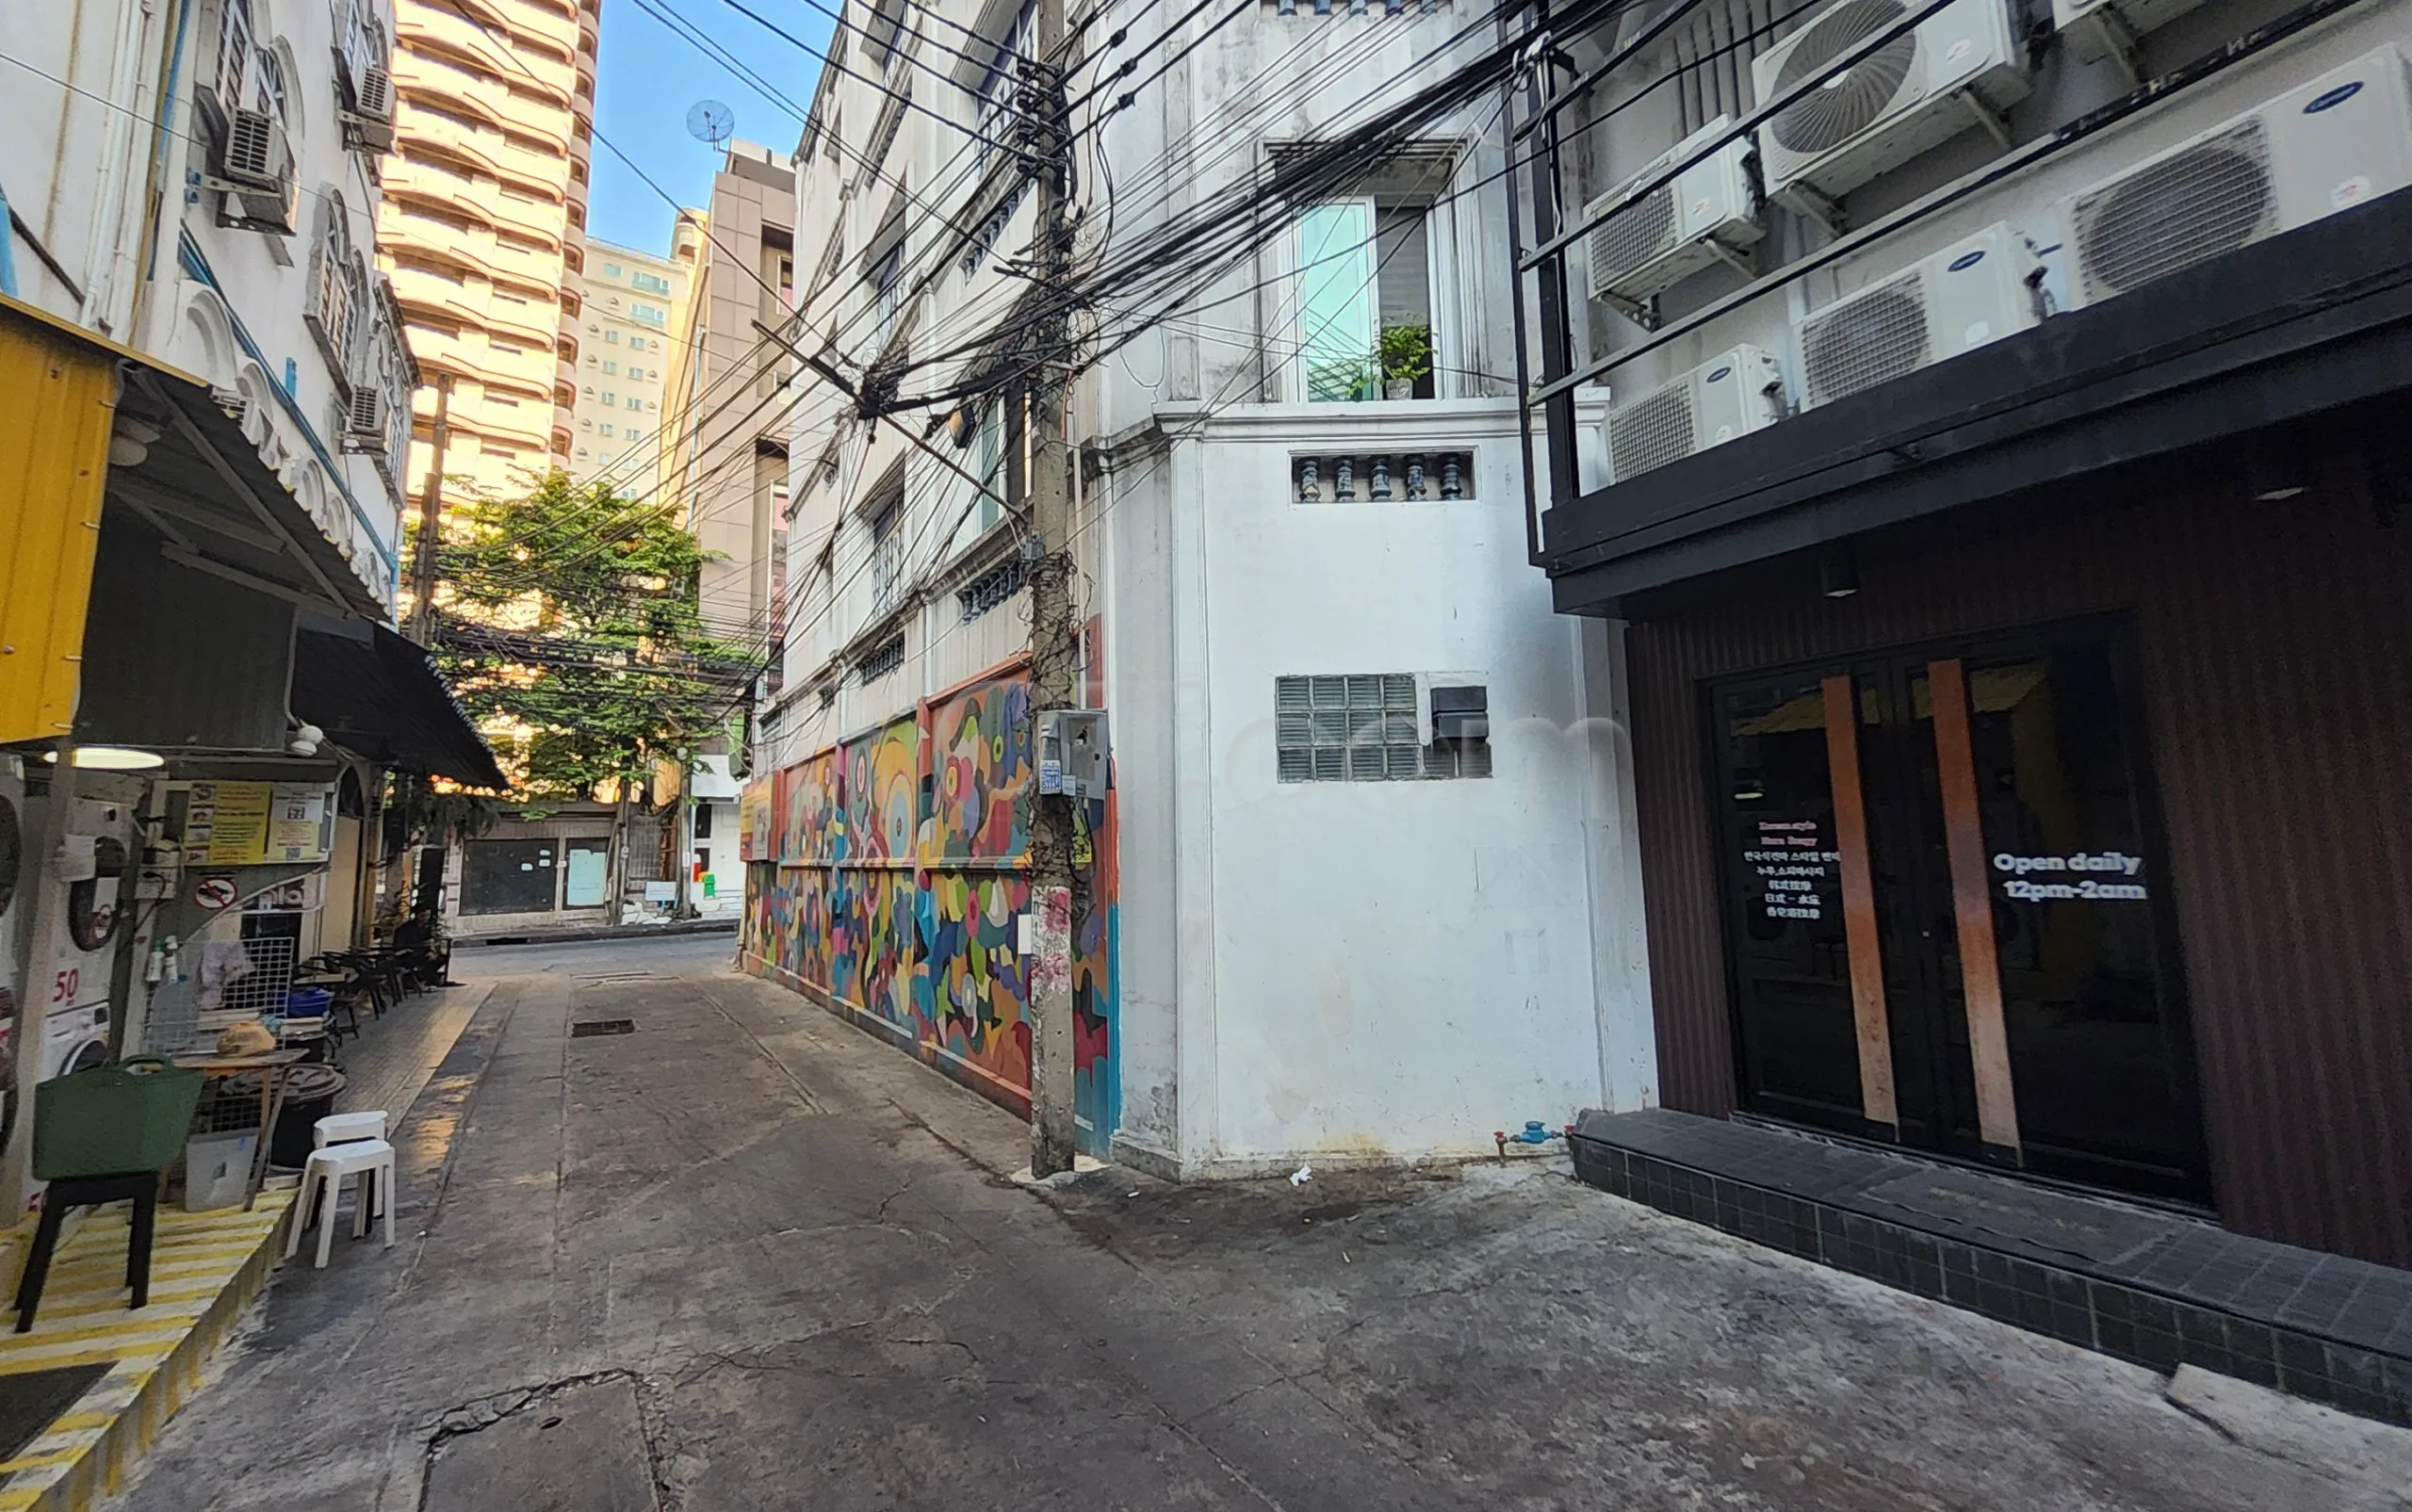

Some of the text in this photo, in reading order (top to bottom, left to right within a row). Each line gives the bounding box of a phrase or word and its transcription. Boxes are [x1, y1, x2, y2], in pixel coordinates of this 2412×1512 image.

[1994, 852, 2142, 874] Open daily
[2003, 881, 2146, 902] 12pm-2am
[53, 968, 79, 1002] 50
